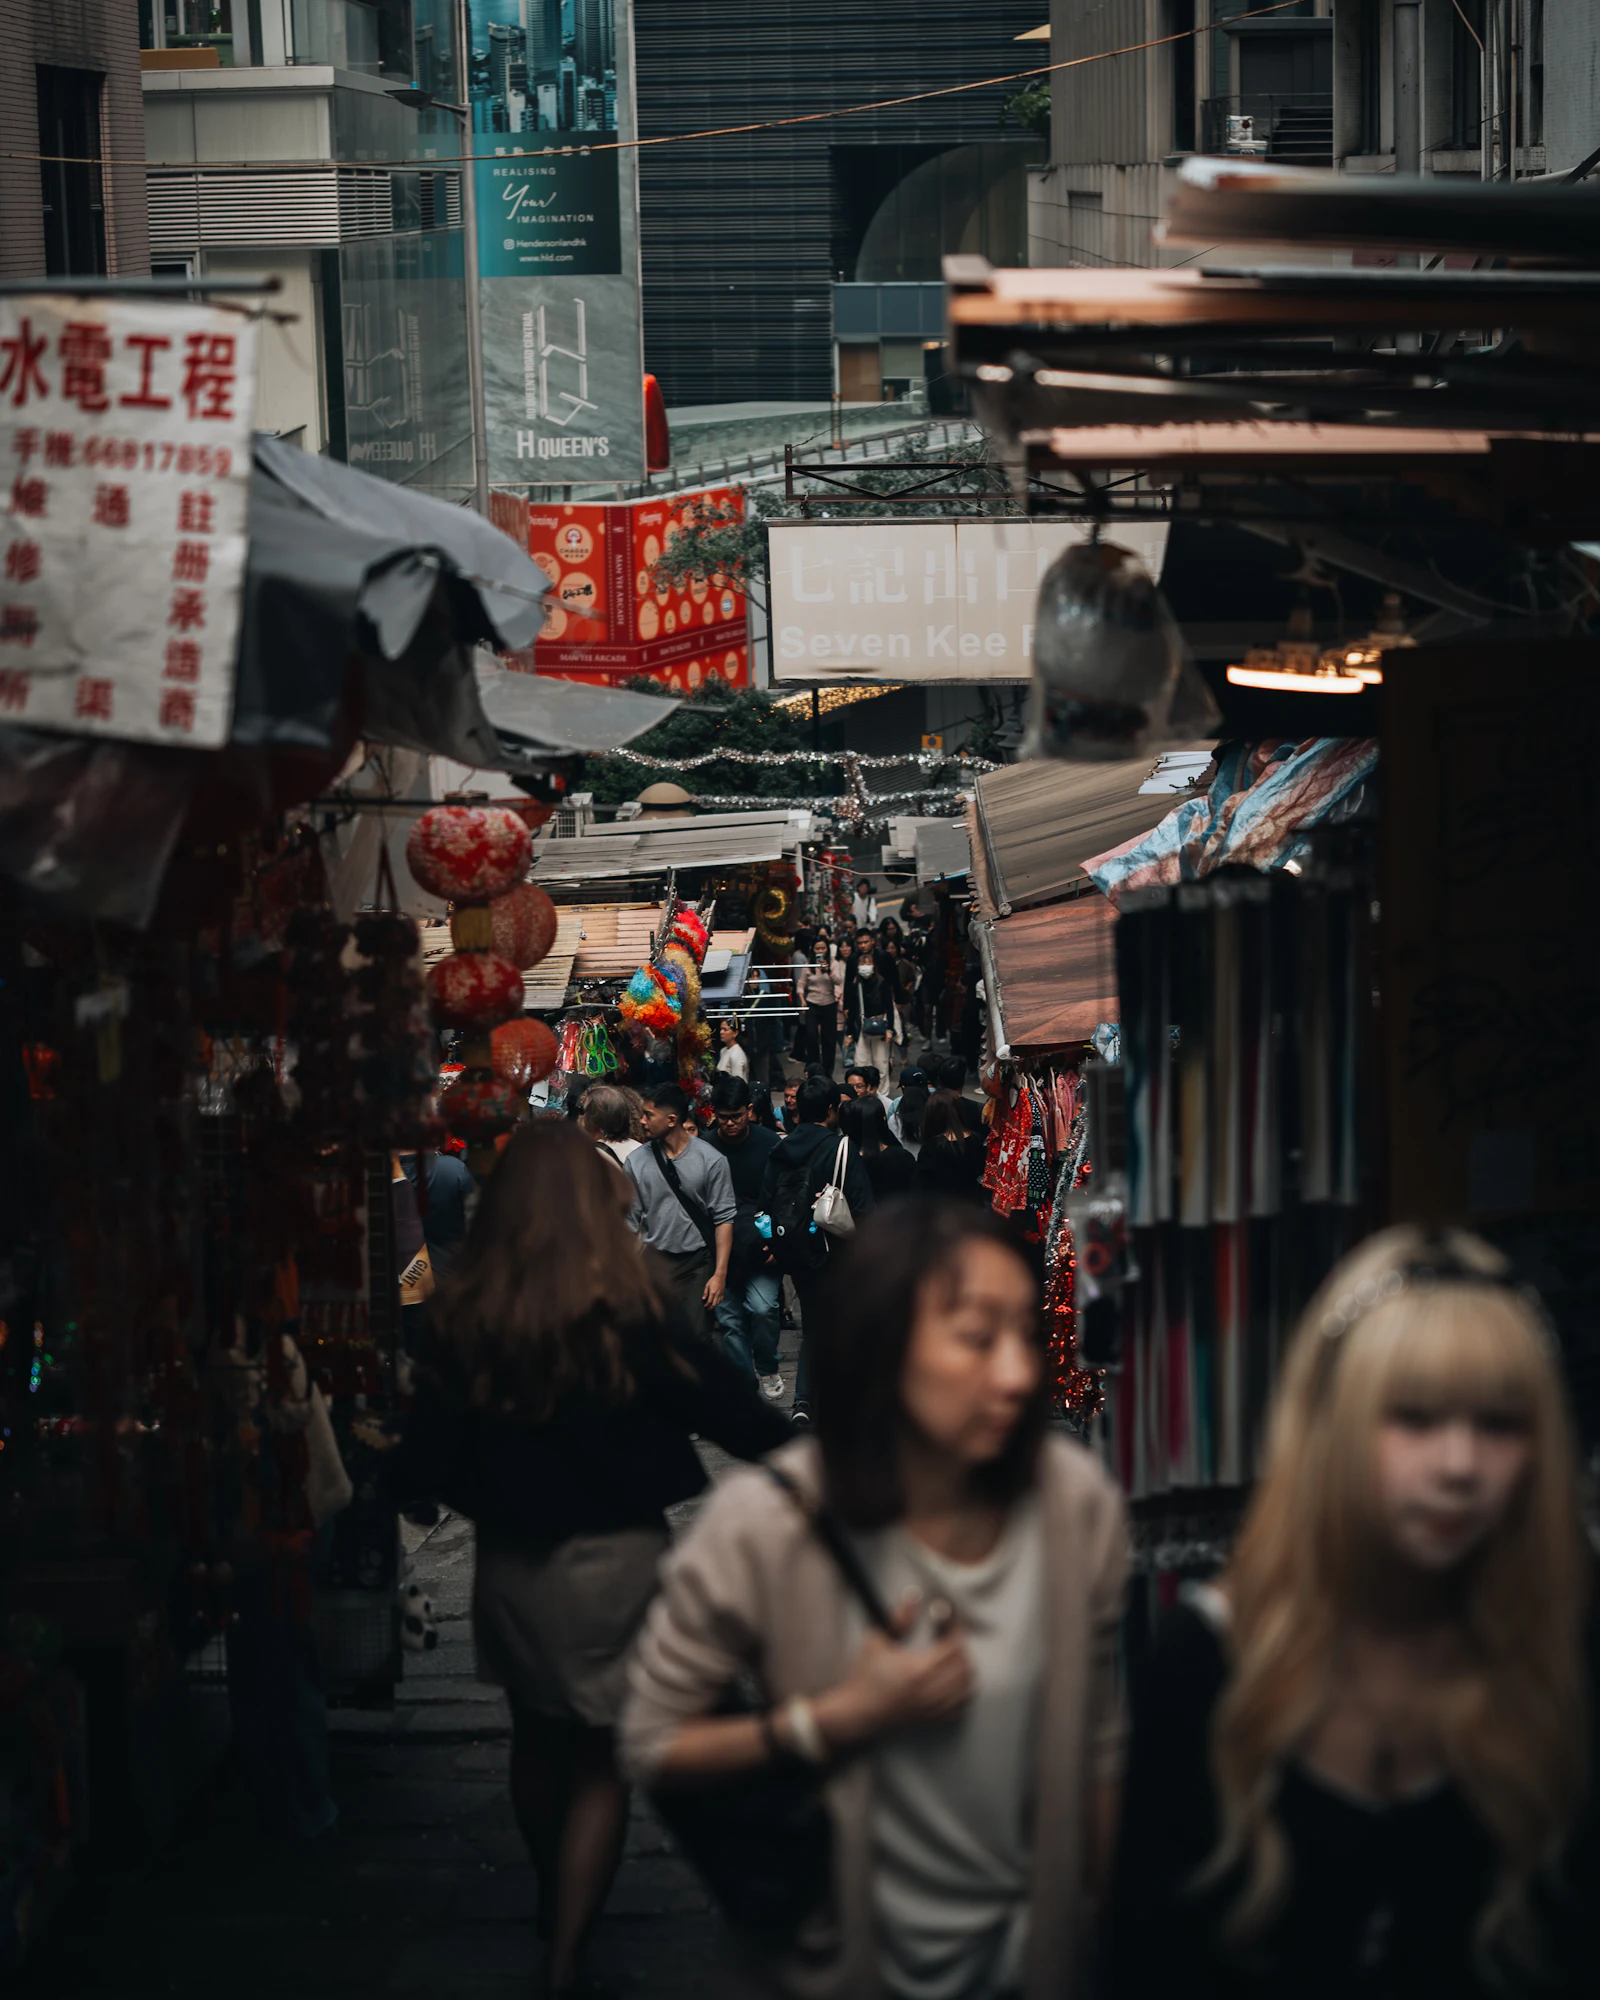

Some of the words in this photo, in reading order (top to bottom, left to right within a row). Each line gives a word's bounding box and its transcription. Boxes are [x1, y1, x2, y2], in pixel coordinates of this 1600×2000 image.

[493, 167, 557, 176] REALISING
[502, 183, 557, 220] Your
[516, 214, 594, 223] IMAGINATION
[0, 316, 238, 423] 水電工程
[517, 430, 535, 459] H
[538, 436, 610, 460] QUEEN'S
[780, 626, 911, 659] Seven
[926, 624, 1007, 658] Kee
[402, 1259, 428, 1288] GIANT
